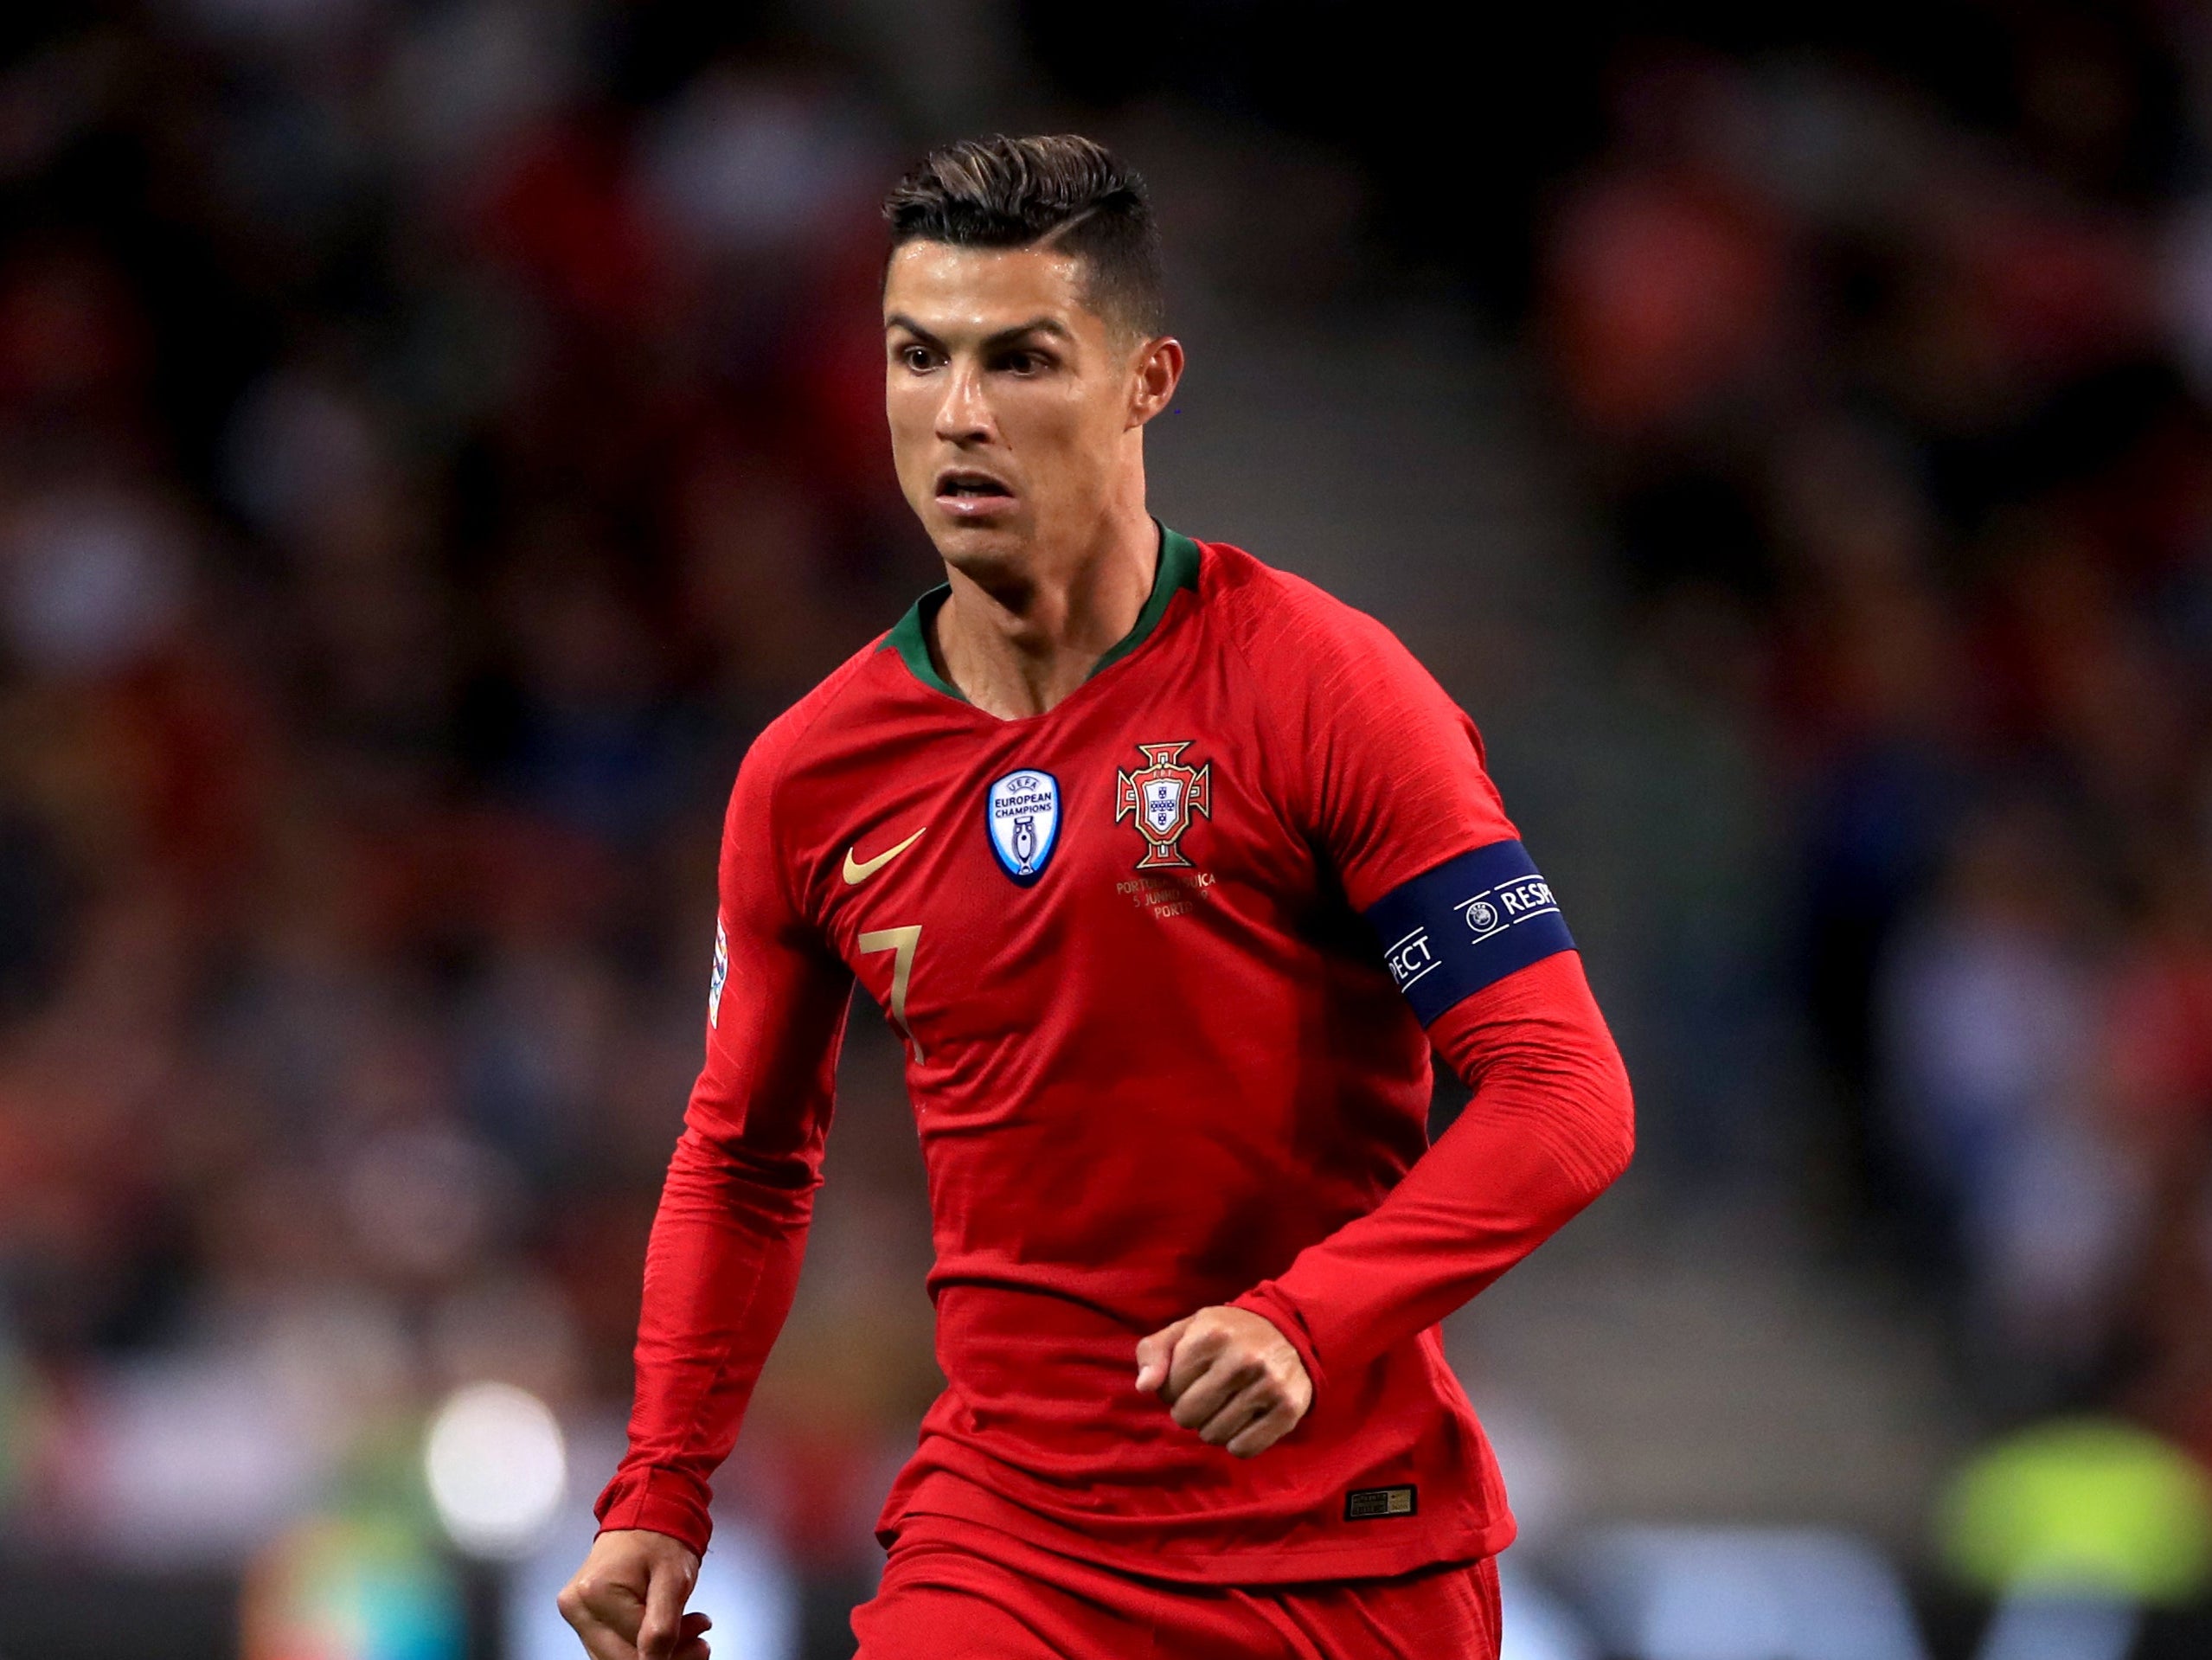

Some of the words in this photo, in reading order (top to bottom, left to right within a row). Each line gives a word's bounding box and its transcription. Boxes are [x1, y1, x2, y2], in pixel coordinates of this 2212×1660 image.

[1008, 779, 1037, 792] UEFA
[995, 792, 1052, 808] EUROPEAN
[995, 803, 1052, 818] CHAMPIONS
[1132, 895, 1141, 907] 5
[1154, 901, 1193, 920] PORTO
[857, 924, 925, 1067] 7
